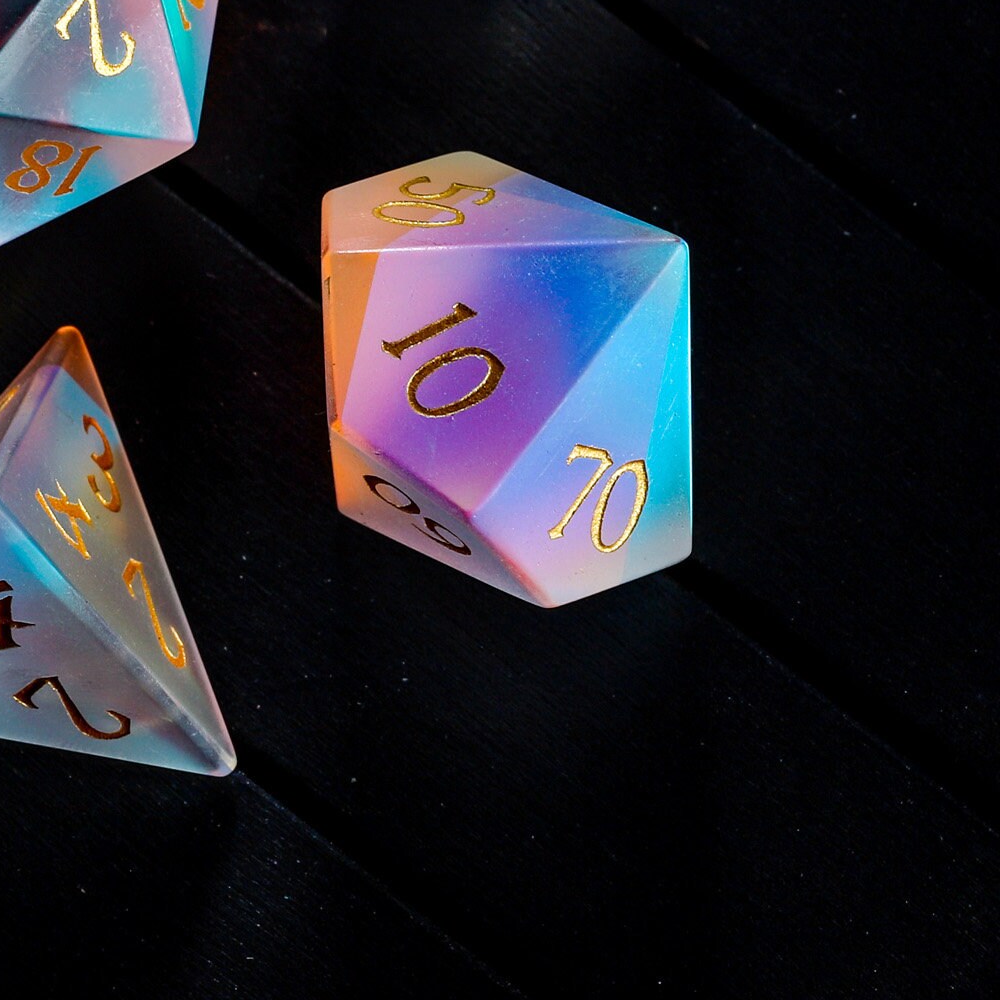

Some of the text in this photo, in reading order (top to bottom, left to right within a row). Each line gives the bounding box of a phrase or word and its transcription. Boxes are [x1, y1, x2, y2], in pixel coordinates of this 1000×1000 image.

[4, 139, 103, 197] 18
[372, 176, 496, 228] 50
[381, 302, 506, 419] 10
[82, 413, 121, 512] 3
[547, 443, 648, 554] 70
[35, 478, 92, 560] 4
[122, 558, 186, 668] 2
[13, 675, 131, 740] 2
